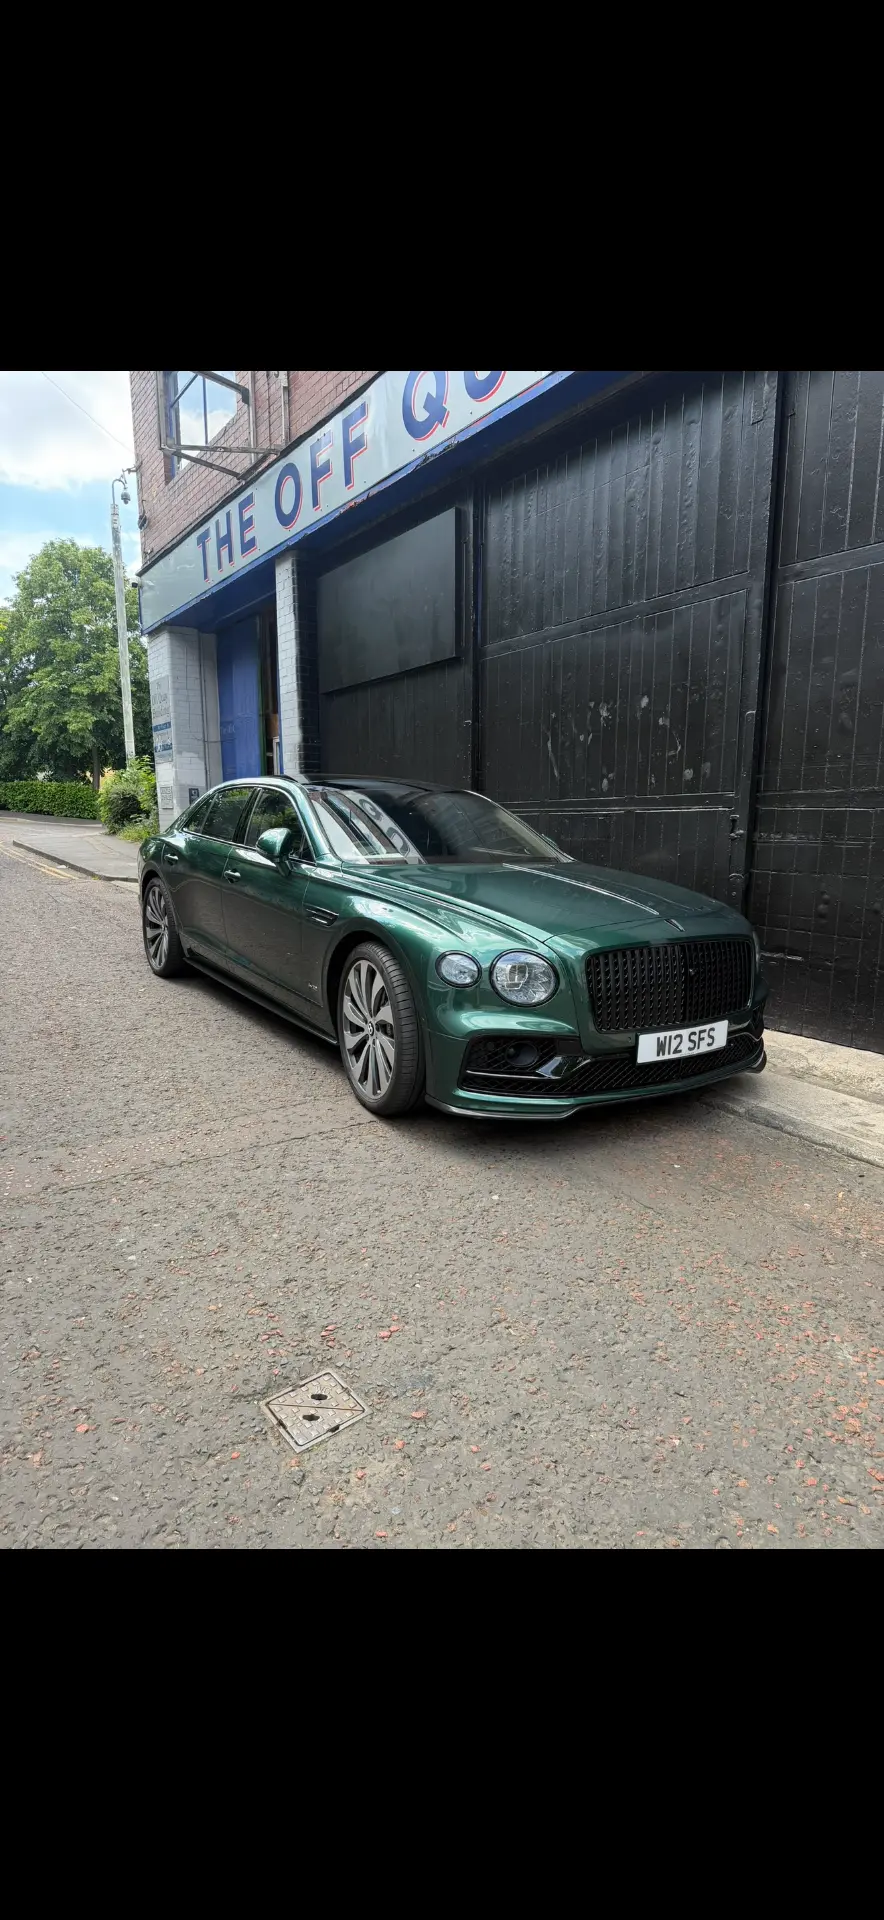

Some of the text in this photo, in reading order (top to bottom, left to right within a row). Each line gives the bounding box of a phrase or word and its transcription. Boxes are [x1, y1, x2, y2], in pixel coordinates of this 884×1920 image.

[196, 371, 507, 584] THE OFF Q
[656, 1027, 716, 1057] W12 SFS
